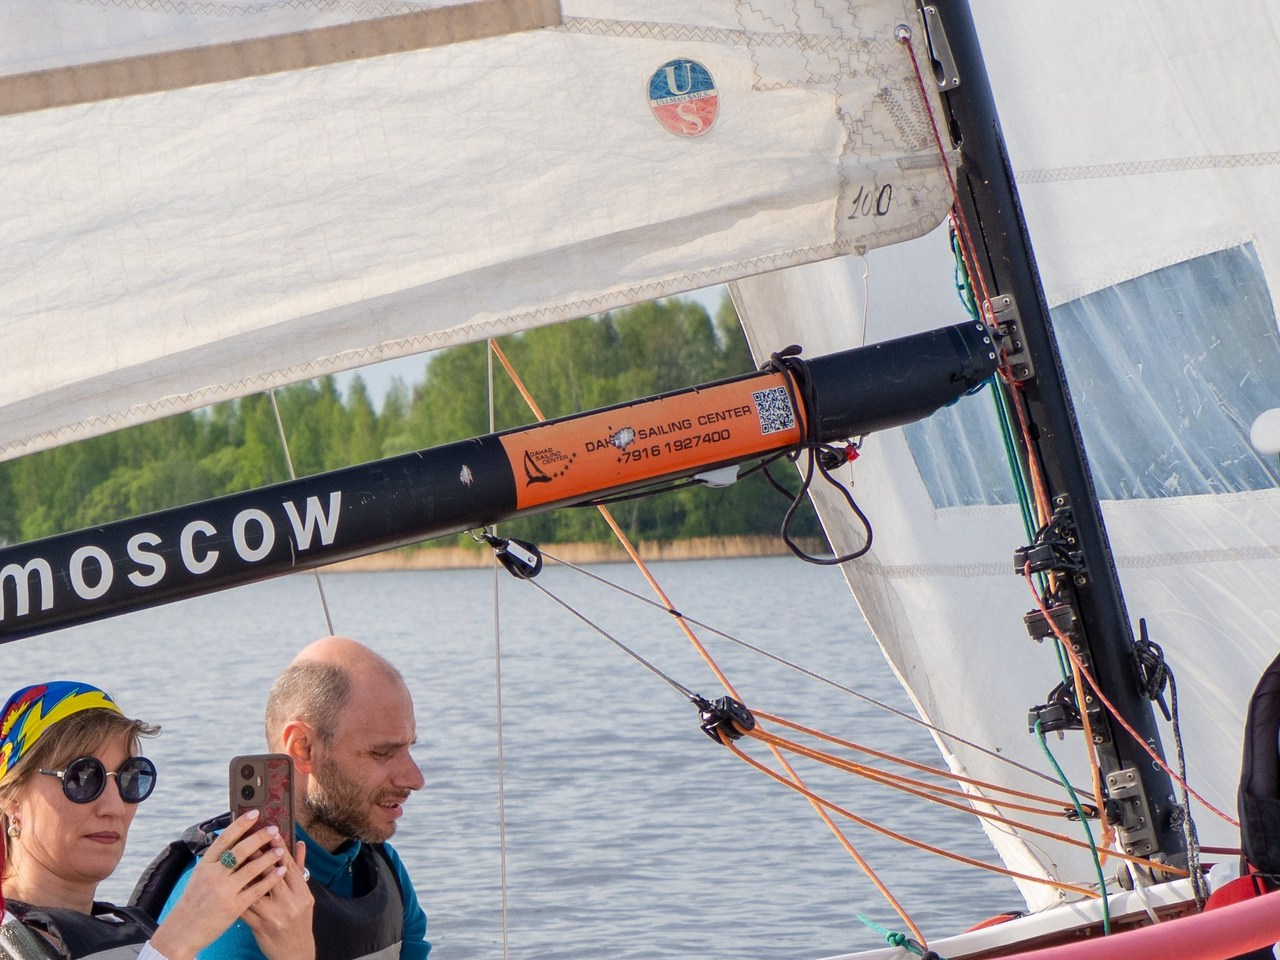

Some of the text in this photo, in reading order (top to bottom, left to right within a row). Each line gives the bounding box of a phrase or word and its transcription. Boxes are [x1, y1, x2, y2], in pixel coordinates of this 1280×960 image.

[664, 63, 693, 95] U
[677, 102, 703, 134] S
[848, 183, 893, 220] 100
[585, 405, 752, 452] DAH SAILING CENTER
[542, 455, 568, 465] CENTER
[617, 429, 731, 464] +7916 1927400
